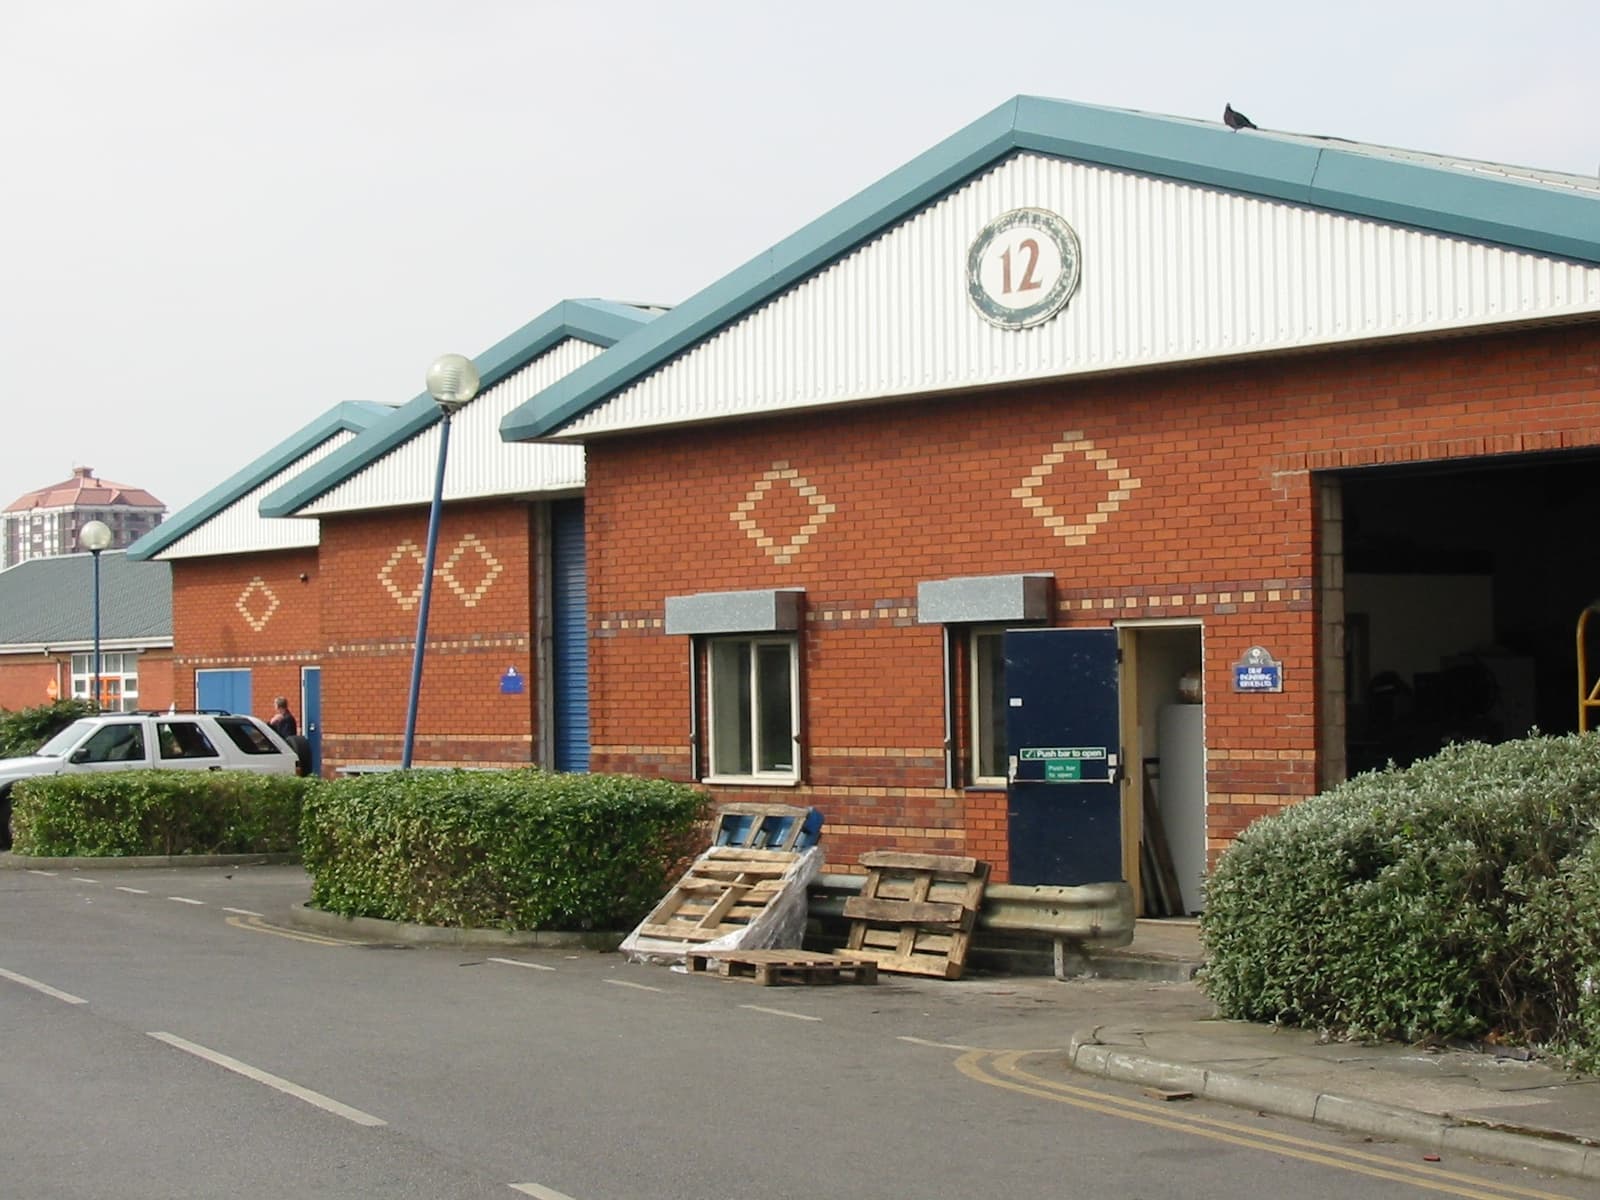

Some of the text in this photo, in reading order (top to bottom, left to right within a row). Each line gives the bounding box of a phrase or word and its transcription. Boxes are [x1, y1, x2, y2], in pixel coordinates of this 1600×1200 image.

[999, 239, 1044, 295] 12
[1037, 750, 1057, 758] Push
[1072, 749, 1081, 757] to
[1081, 750, 1102, 759] open
